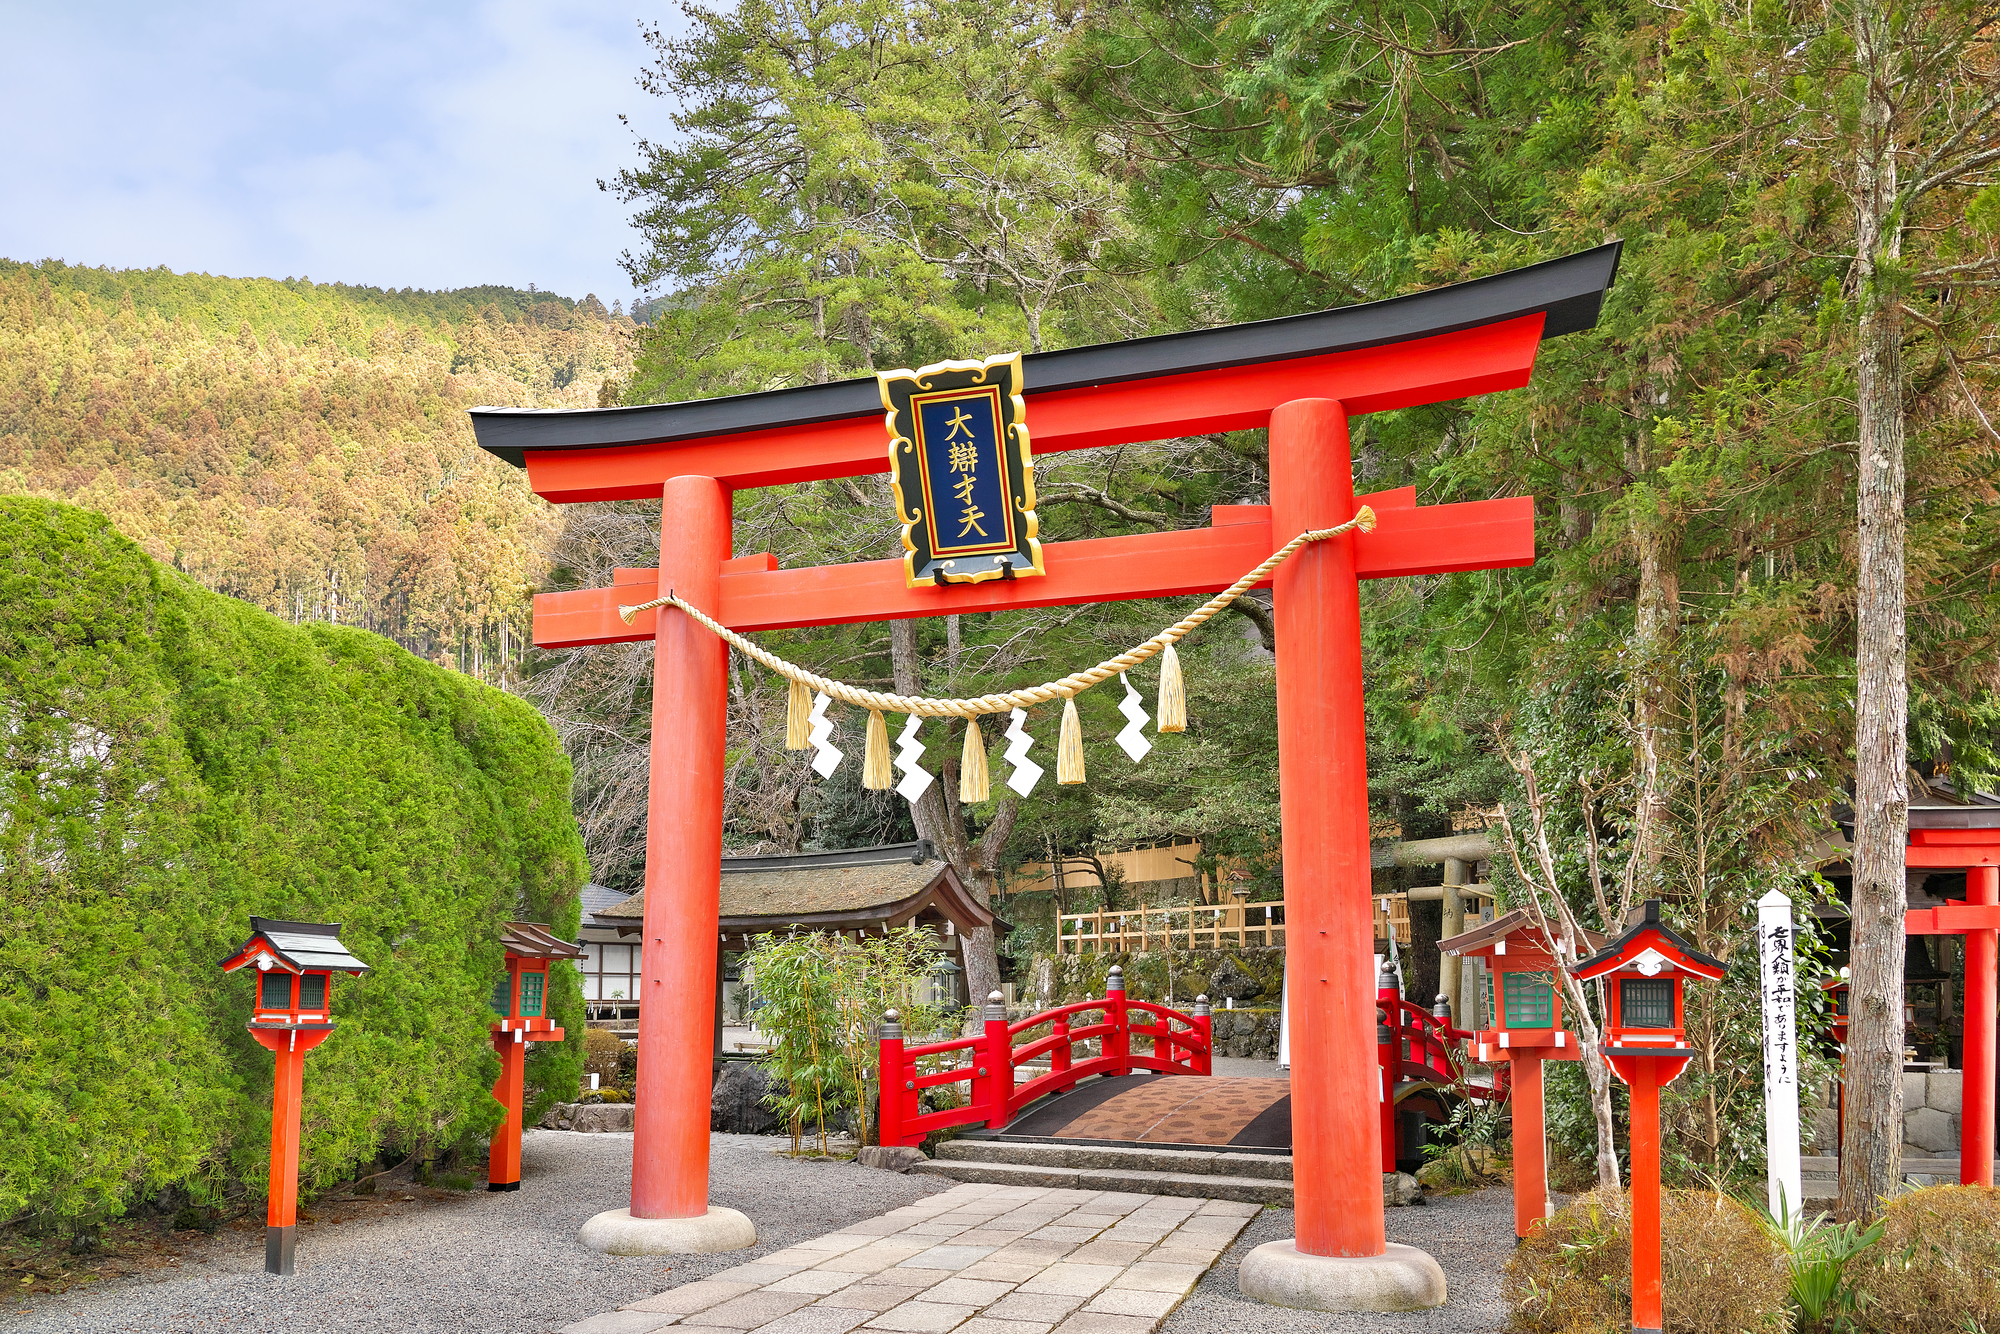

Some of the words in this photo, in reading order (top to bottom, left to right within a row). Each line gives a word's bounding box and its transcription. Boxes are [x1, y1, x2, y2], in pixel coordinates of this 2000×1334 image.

[1768, 926, 1791, 1084] 世界人類が平和でありますように
